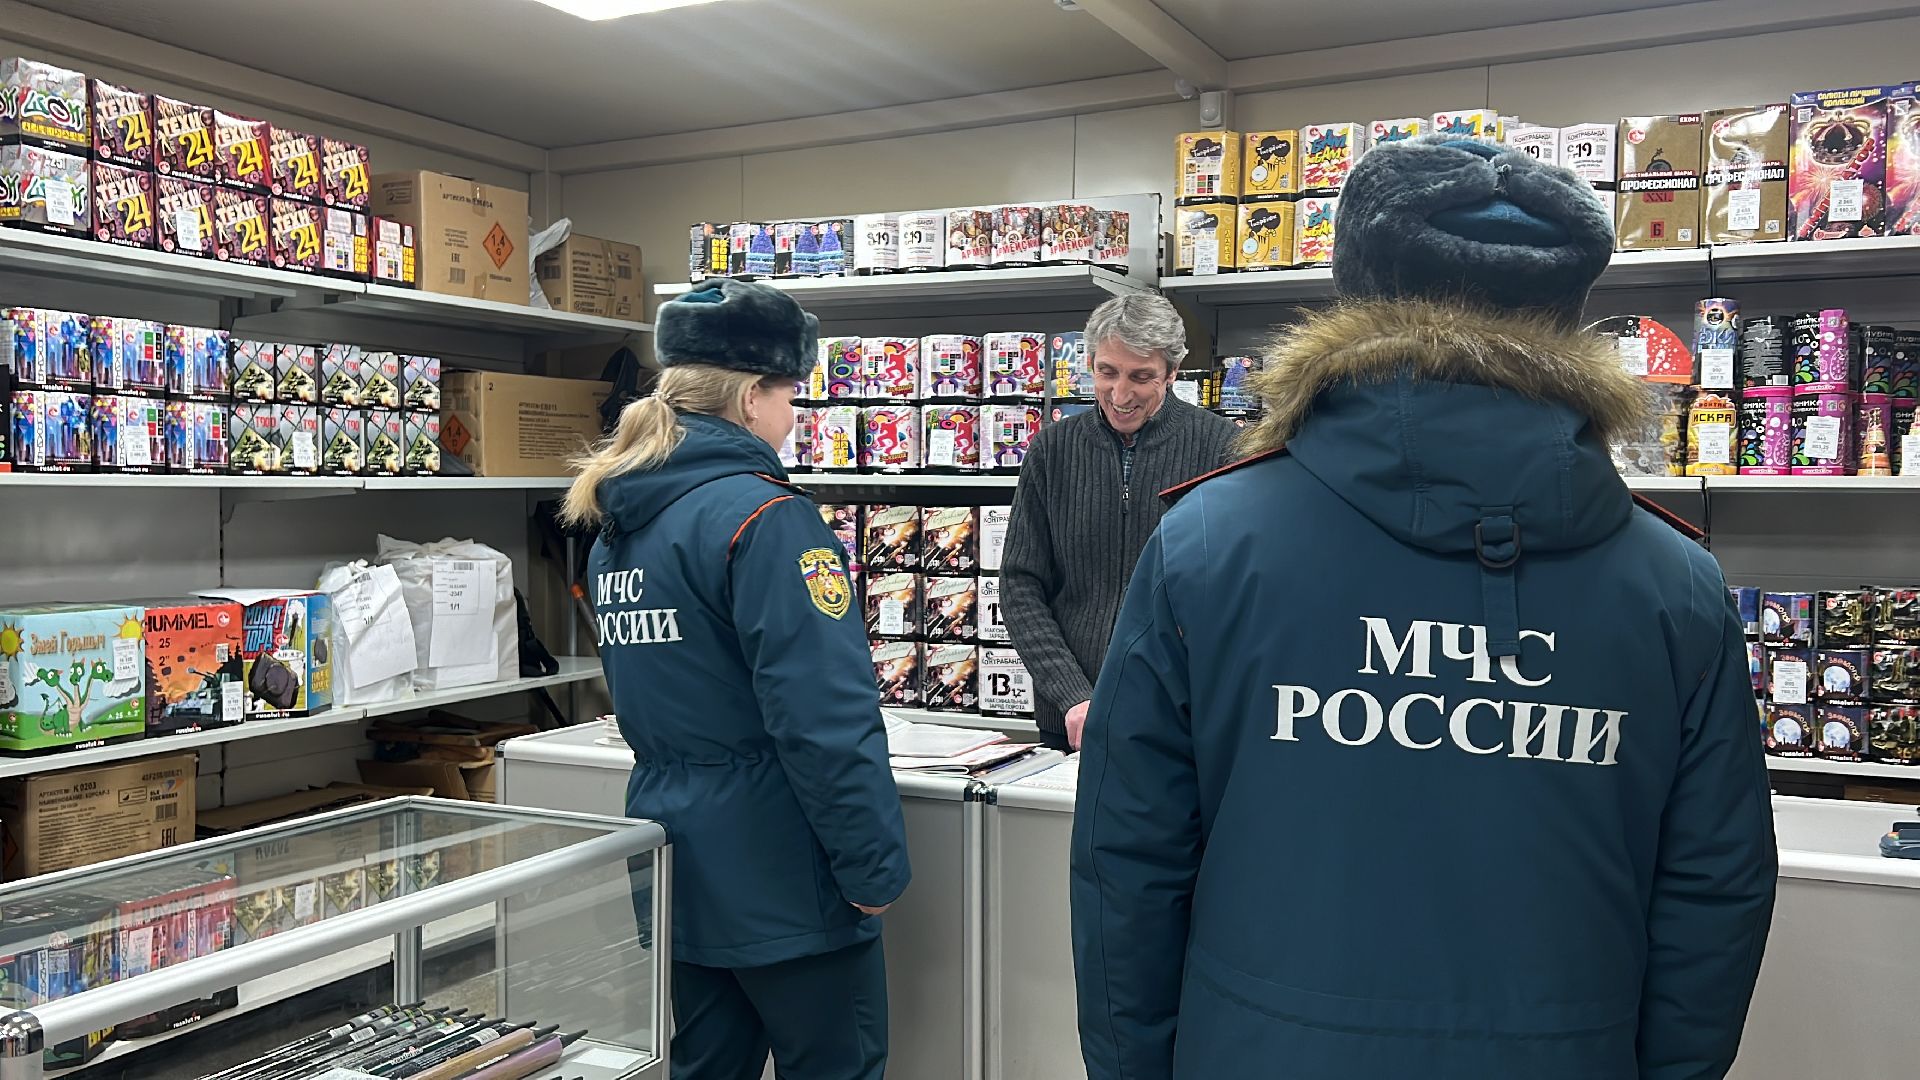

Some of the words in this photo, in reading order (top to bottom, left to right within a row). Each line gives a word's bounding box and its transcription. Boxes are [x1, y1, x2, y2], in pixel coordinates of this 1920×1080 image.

[117, 111, 151, 152] 24
[180, 127, 213, 168] 24
[230, 139, 263, 176] 24
[1575, 142, 1592, 157] 19
[288, 152, 319, 189] 24
[340, 164, 369, 200] 24
[1705, 168, 1785, 185] ПРОФЕССИОНАЛ
[1621, 178, 1697, 191] ПРОФЕССИОНАЛ
[1647, 192, 1671, 201] XXL
[117, 193, 151, 234] 24
[236, 217, 266, 254] 24
[290, 223, 321, 261] 24
[491, 234, 505, 247] 1.4
[488, 382, 494, 391] 2
[1693, 412, 1733, 423] ИСКРА
[597, 568, 643, 606] МЧС
[244, 606, 283, 628] МОЛОТ
[450, 603, 460, 611] 1/1
[988, 603, 1004, 625] 1
[145, 612, 214, 633] HUMMEL
[31, 633, 57, 655] Змей
[60, 631, 106, 656] Горыныч
[159, 638, 170, 648] 25
[243, 625, 274, 651] ТОРА
[1357, 616, 1555, 687] МЧС
[988, 673, 1011, 696] 13
[984, 697, 1029, 705] МАКСИМАЛЬНЫЙ
[1269, 684, 1629, 766] РОССИИ
